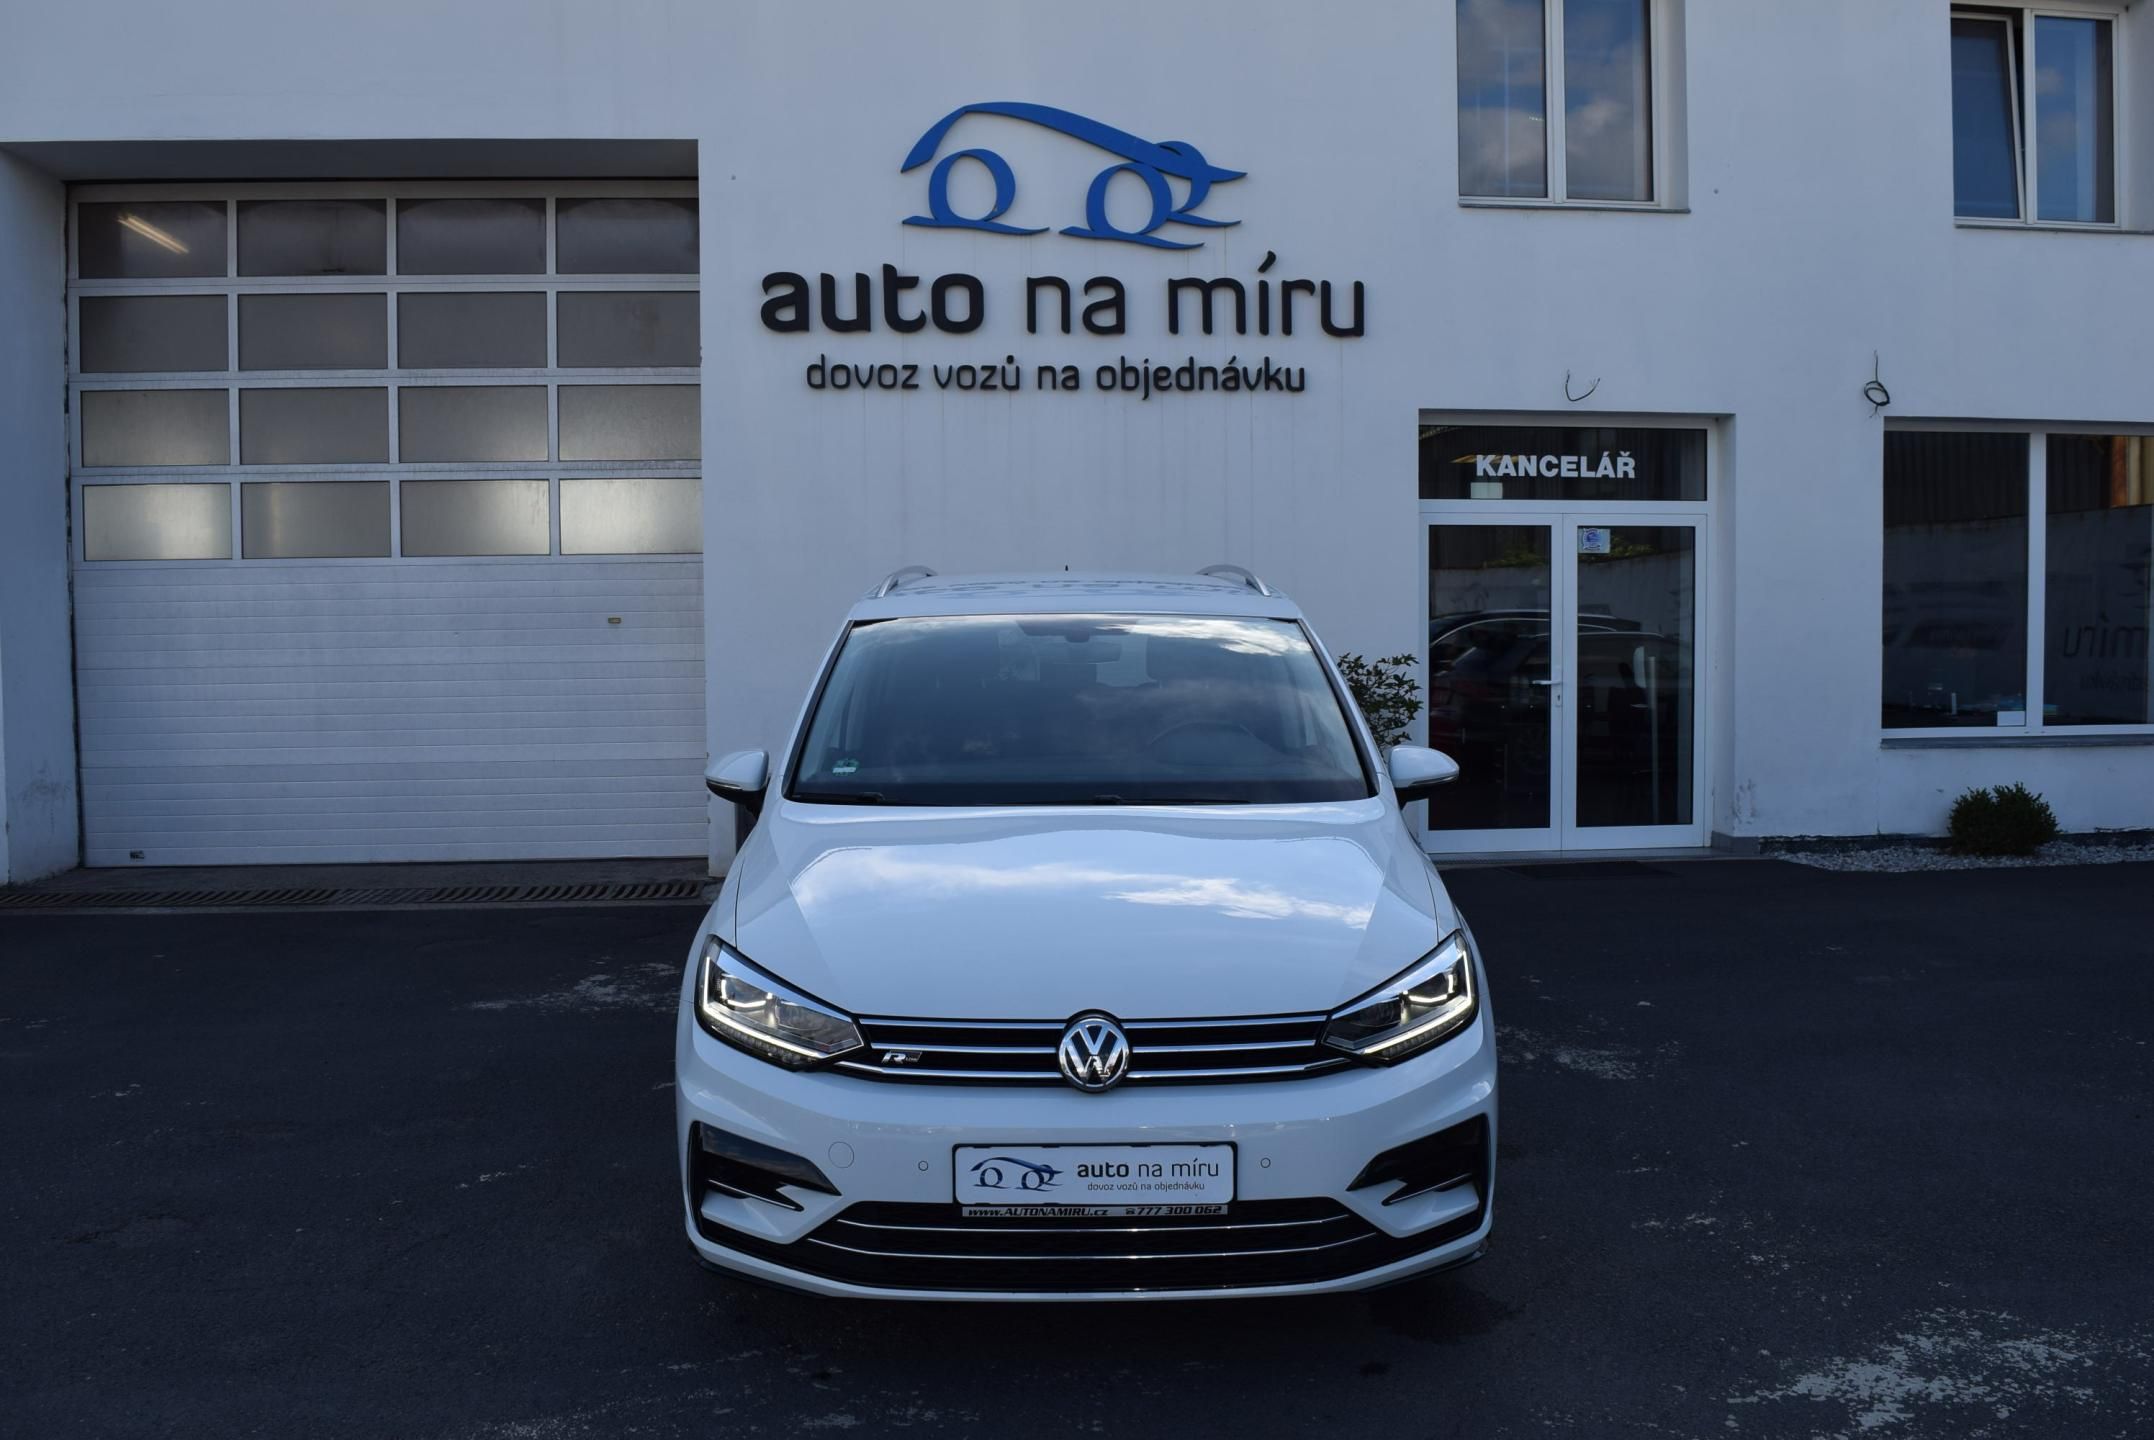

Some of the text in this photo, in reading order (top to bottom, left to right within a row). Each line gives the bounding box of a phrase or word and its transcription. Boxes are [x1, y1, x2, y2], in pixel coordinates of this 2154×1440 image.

[760, 250, 1366, 338] auto na míru
[806, 354, 1306, 401] dovoz vozů na objednávku
[1475, 451, 1637, 480] KANCELÁŘ
[1077, 1157, 1219, 1178] auto na míru
[1087, 1182, 1115, 1191] dovoz
[1140, 1183, 1152, 1191] na
[1154, 1181, 1205, 1193] objednávku
[1164, 1206, 1193, 1215] 300
[1194, 1205, 1222, 1214] 062
